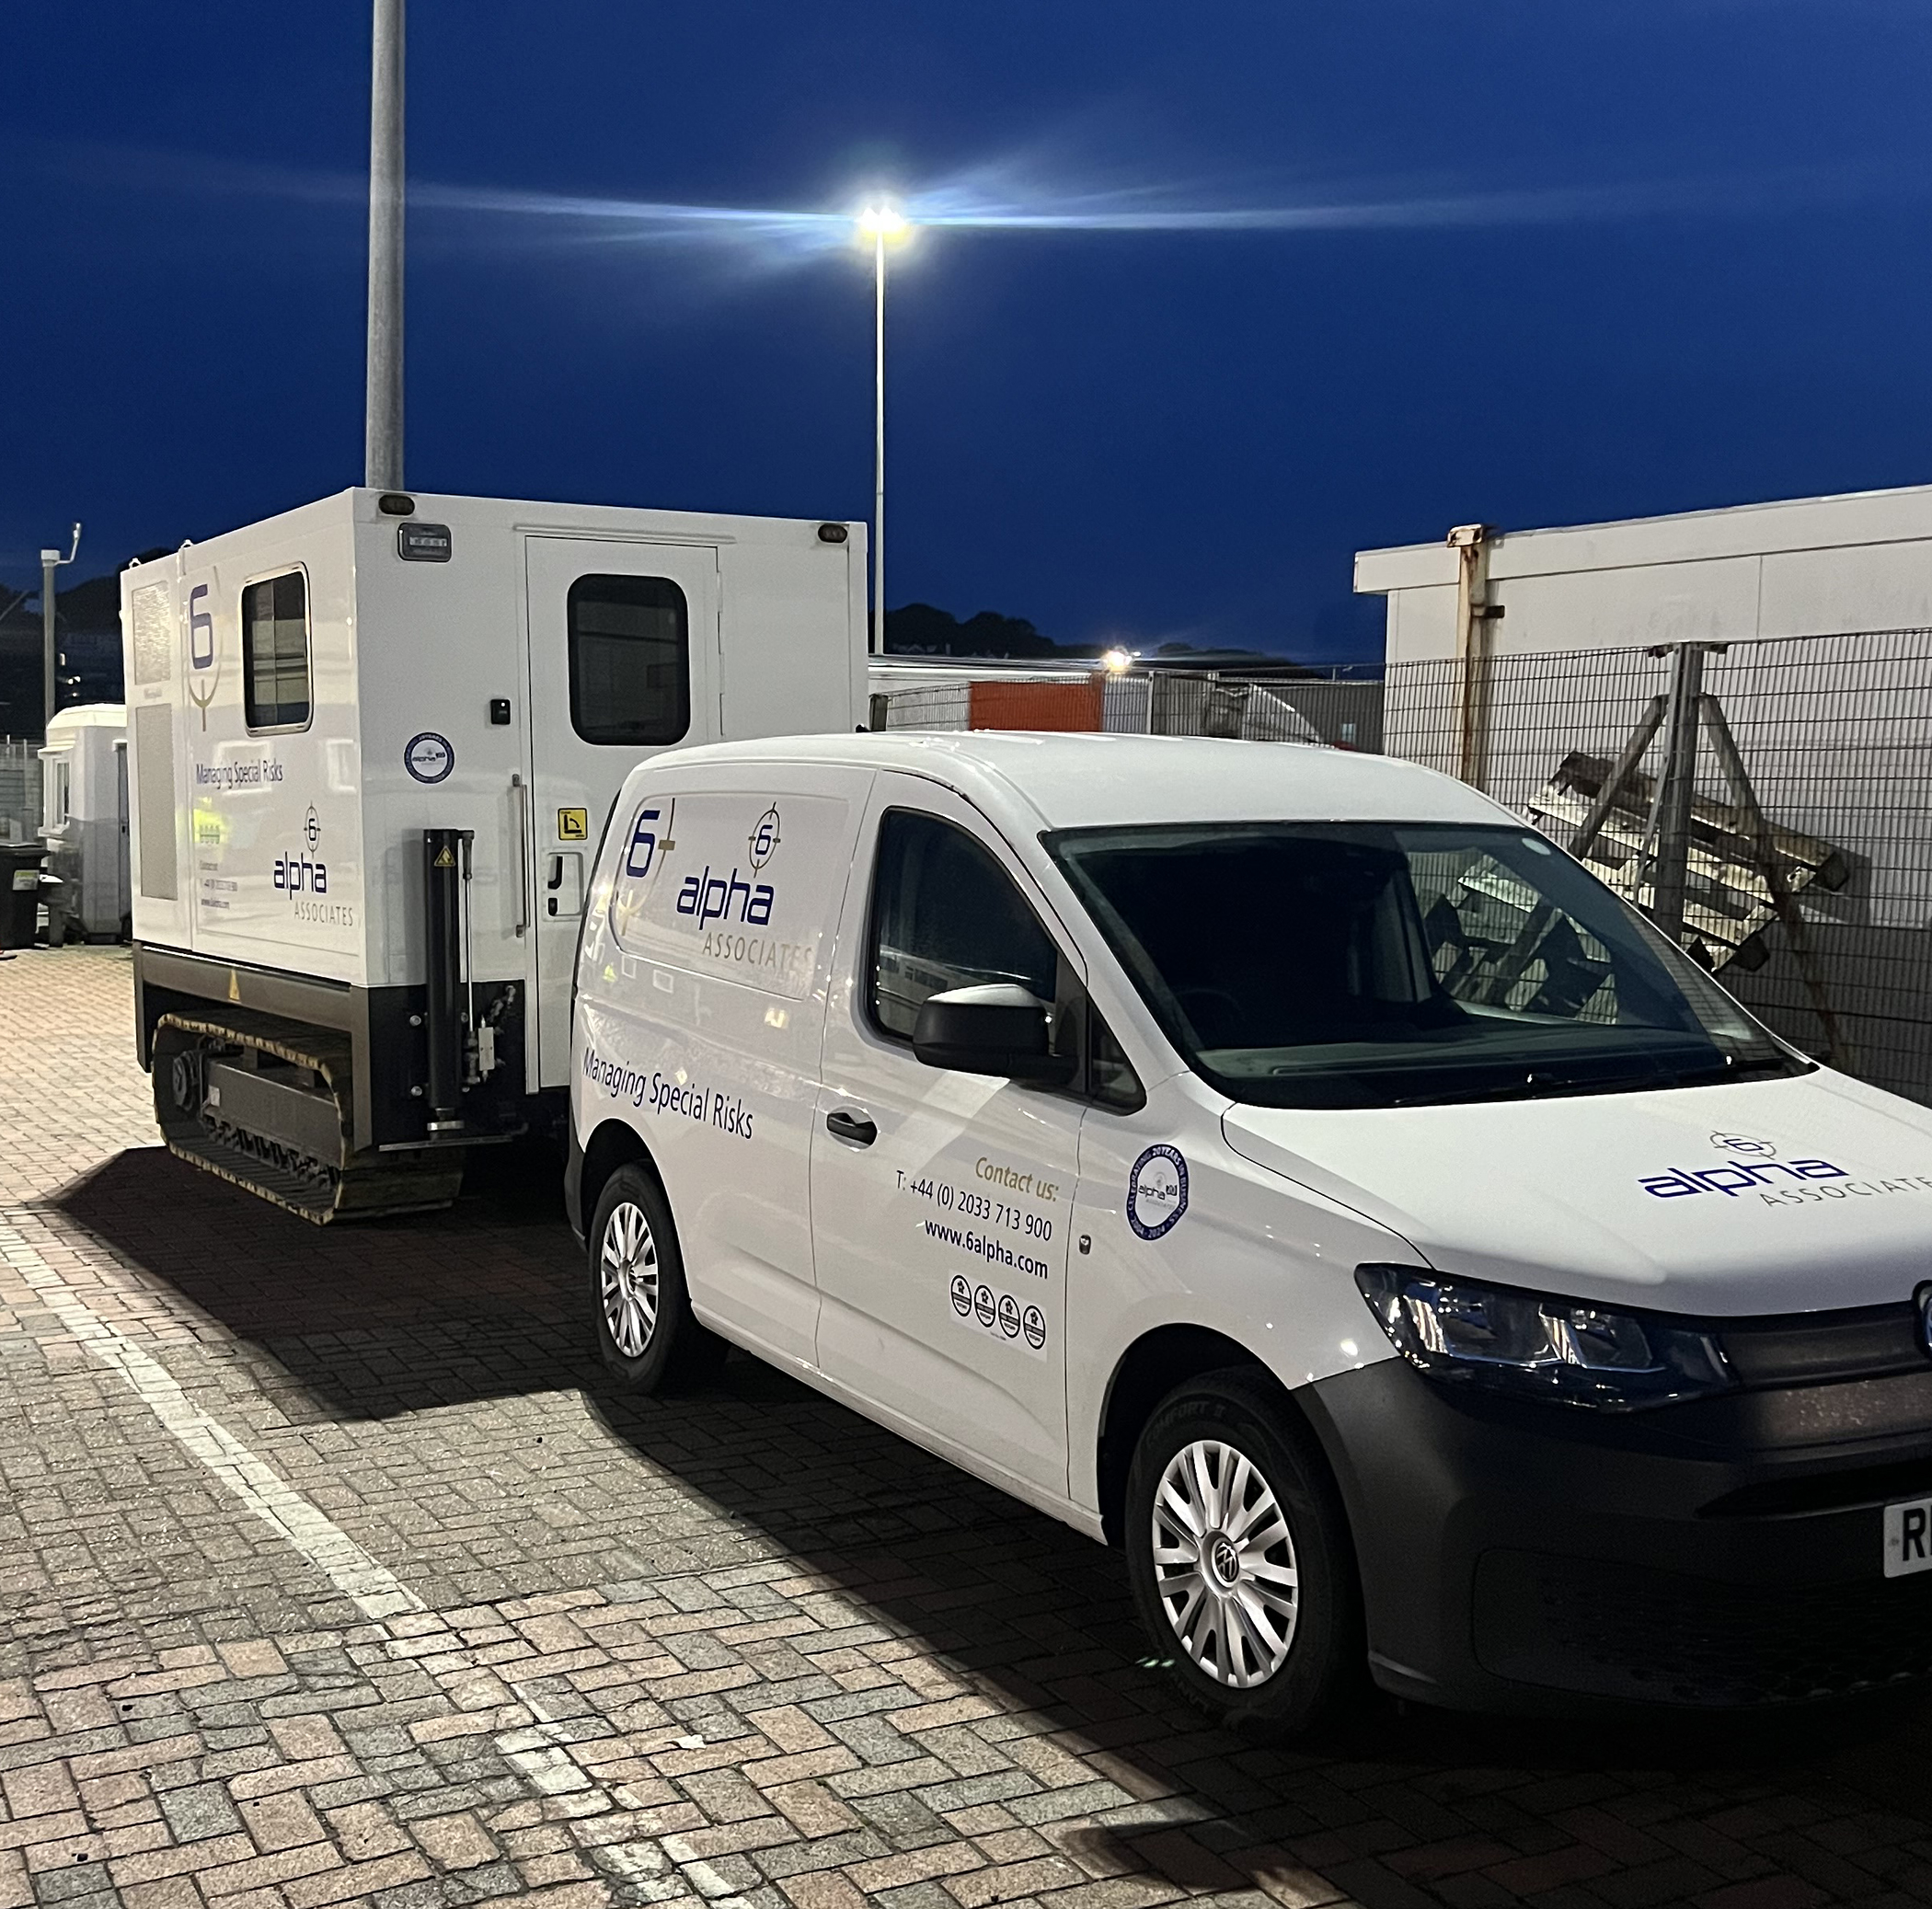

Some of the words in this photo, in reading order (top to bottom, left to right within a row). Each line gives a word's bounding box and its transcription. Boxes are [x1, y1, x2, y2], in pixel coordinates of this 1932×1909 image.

[190, 583, 213, 670] 6
[196, 763, 233, 789] Managing
[234, 759, 260, 788] Special
[263, 758, 283, 782] Risks
[308, 818, 316, 841] 6
[626, 810, 661, 878] 6
[755, 824, 773, 855] 6
[274, 851, 327, 901] alpha
[676, 866, 775, 930] alpha
[294, 902, 353, 926] ASSOCIATES
[702, 932, 813, 972] ASSOCIATES
[582, 1047, 646, 1108] Managing
[649, 1072, 709, 1121] Special
[712, 1093, 753, 1139] Risks
[1723, 1138, 1765, 1152] 6
[975, 1156, 1033, 1194] Contact
[1036, 1180, 1059, 1202] us:
[1638, 1159, 1850, 1198] alpha
[896, 1169, 907, 1191] T:
[910, 1179, 934, 1200] +44
[937, 1183, 954, 1211] (0)
[958, 1191, 991, 1220] 2033
[995, 1203, 1021, 1230] 713
[1025, 1213, 1052, 1242] 900
[925, 1220, 1048, 1279] www.6alpha.com
[1903, 1507, 1932, 1561] R
